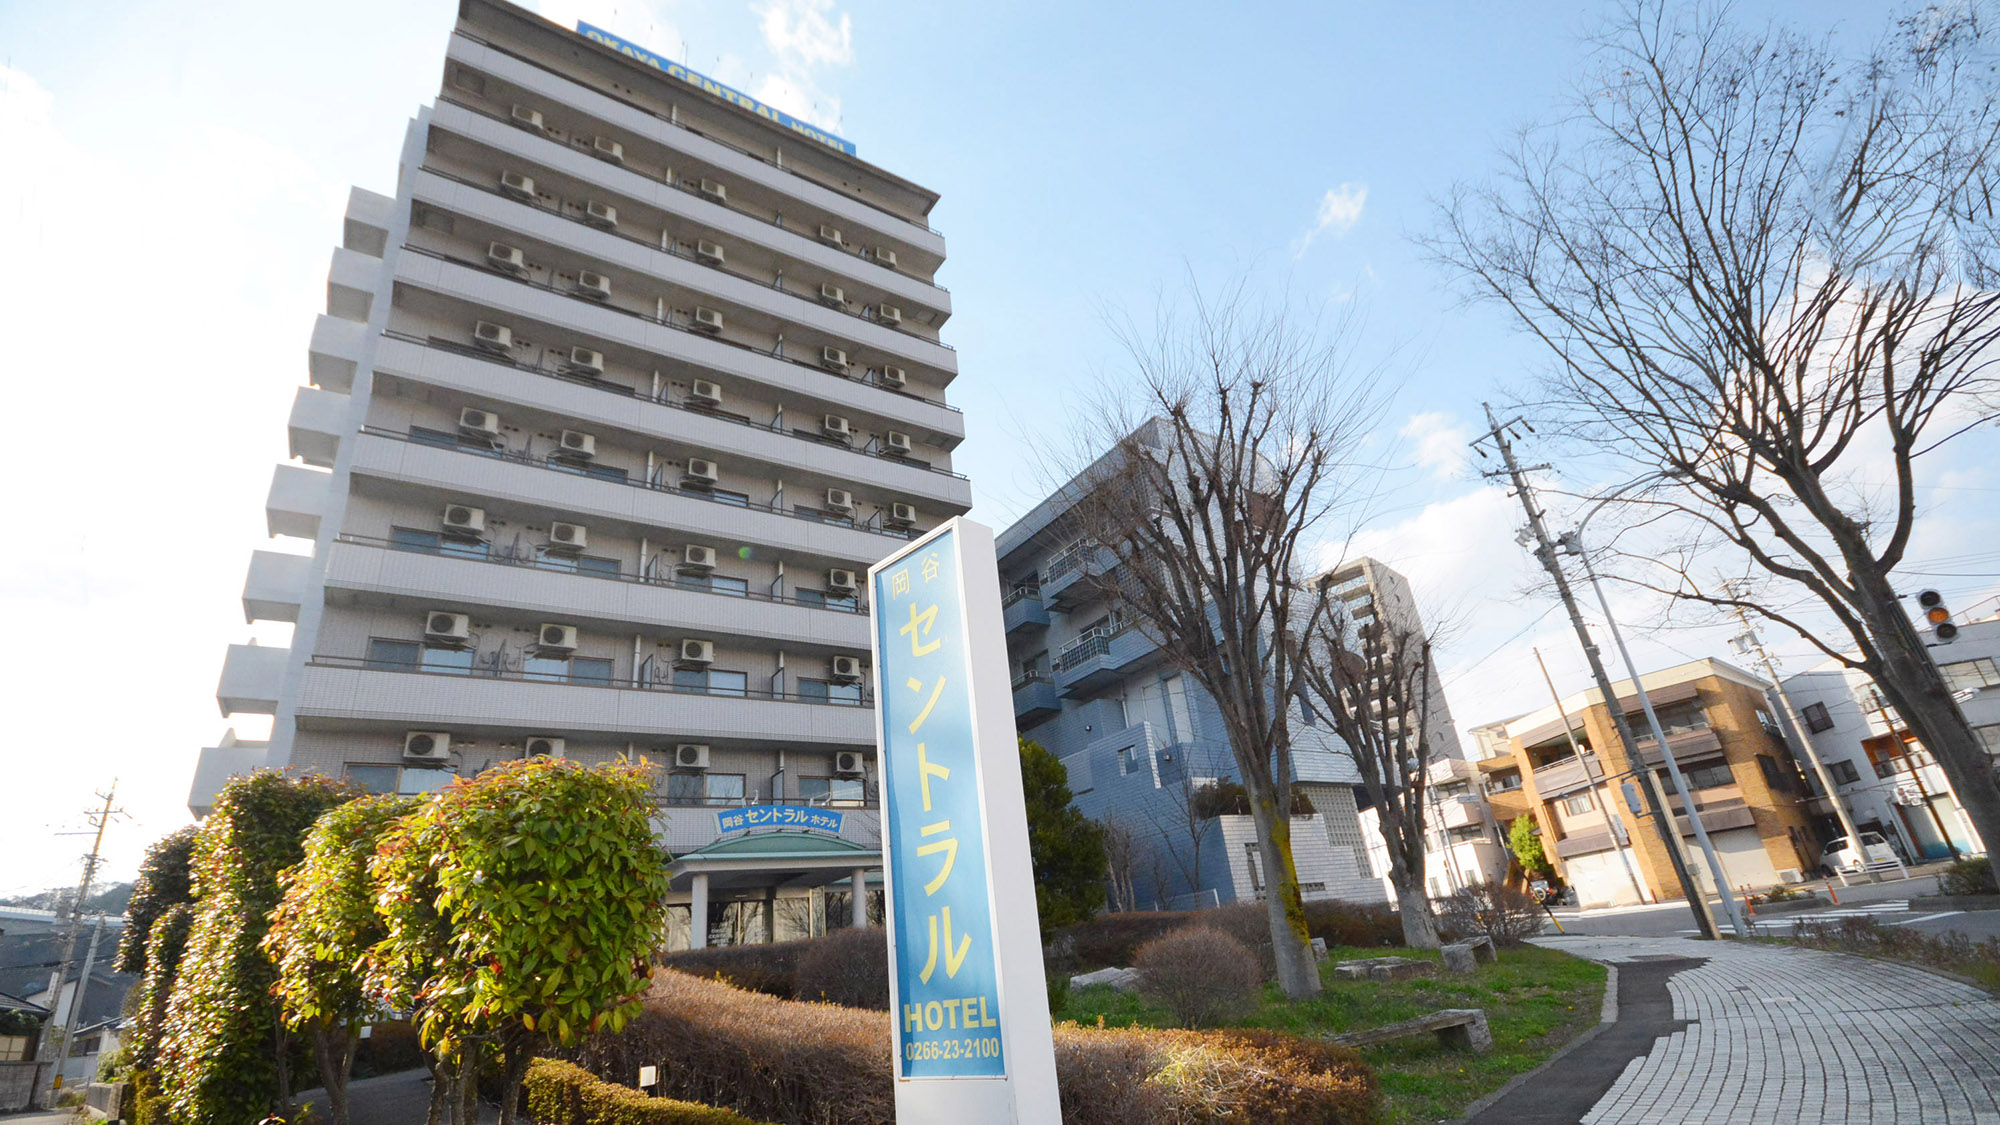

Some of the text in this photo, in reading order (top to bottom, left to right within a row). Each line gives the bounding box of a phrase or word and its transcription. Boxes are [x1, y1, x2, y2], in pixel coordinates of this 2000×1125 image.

[891, 552, 940, 600] 岡谷
[899, 601, 973, 985] セントラル
[745, 807, 808, 823] セントラル
[810, 815, 838, 828] ホテル
[904, 996, 996, 1033] HOTEL
[905, 1037, 999, 1061] 0266-23-2100
